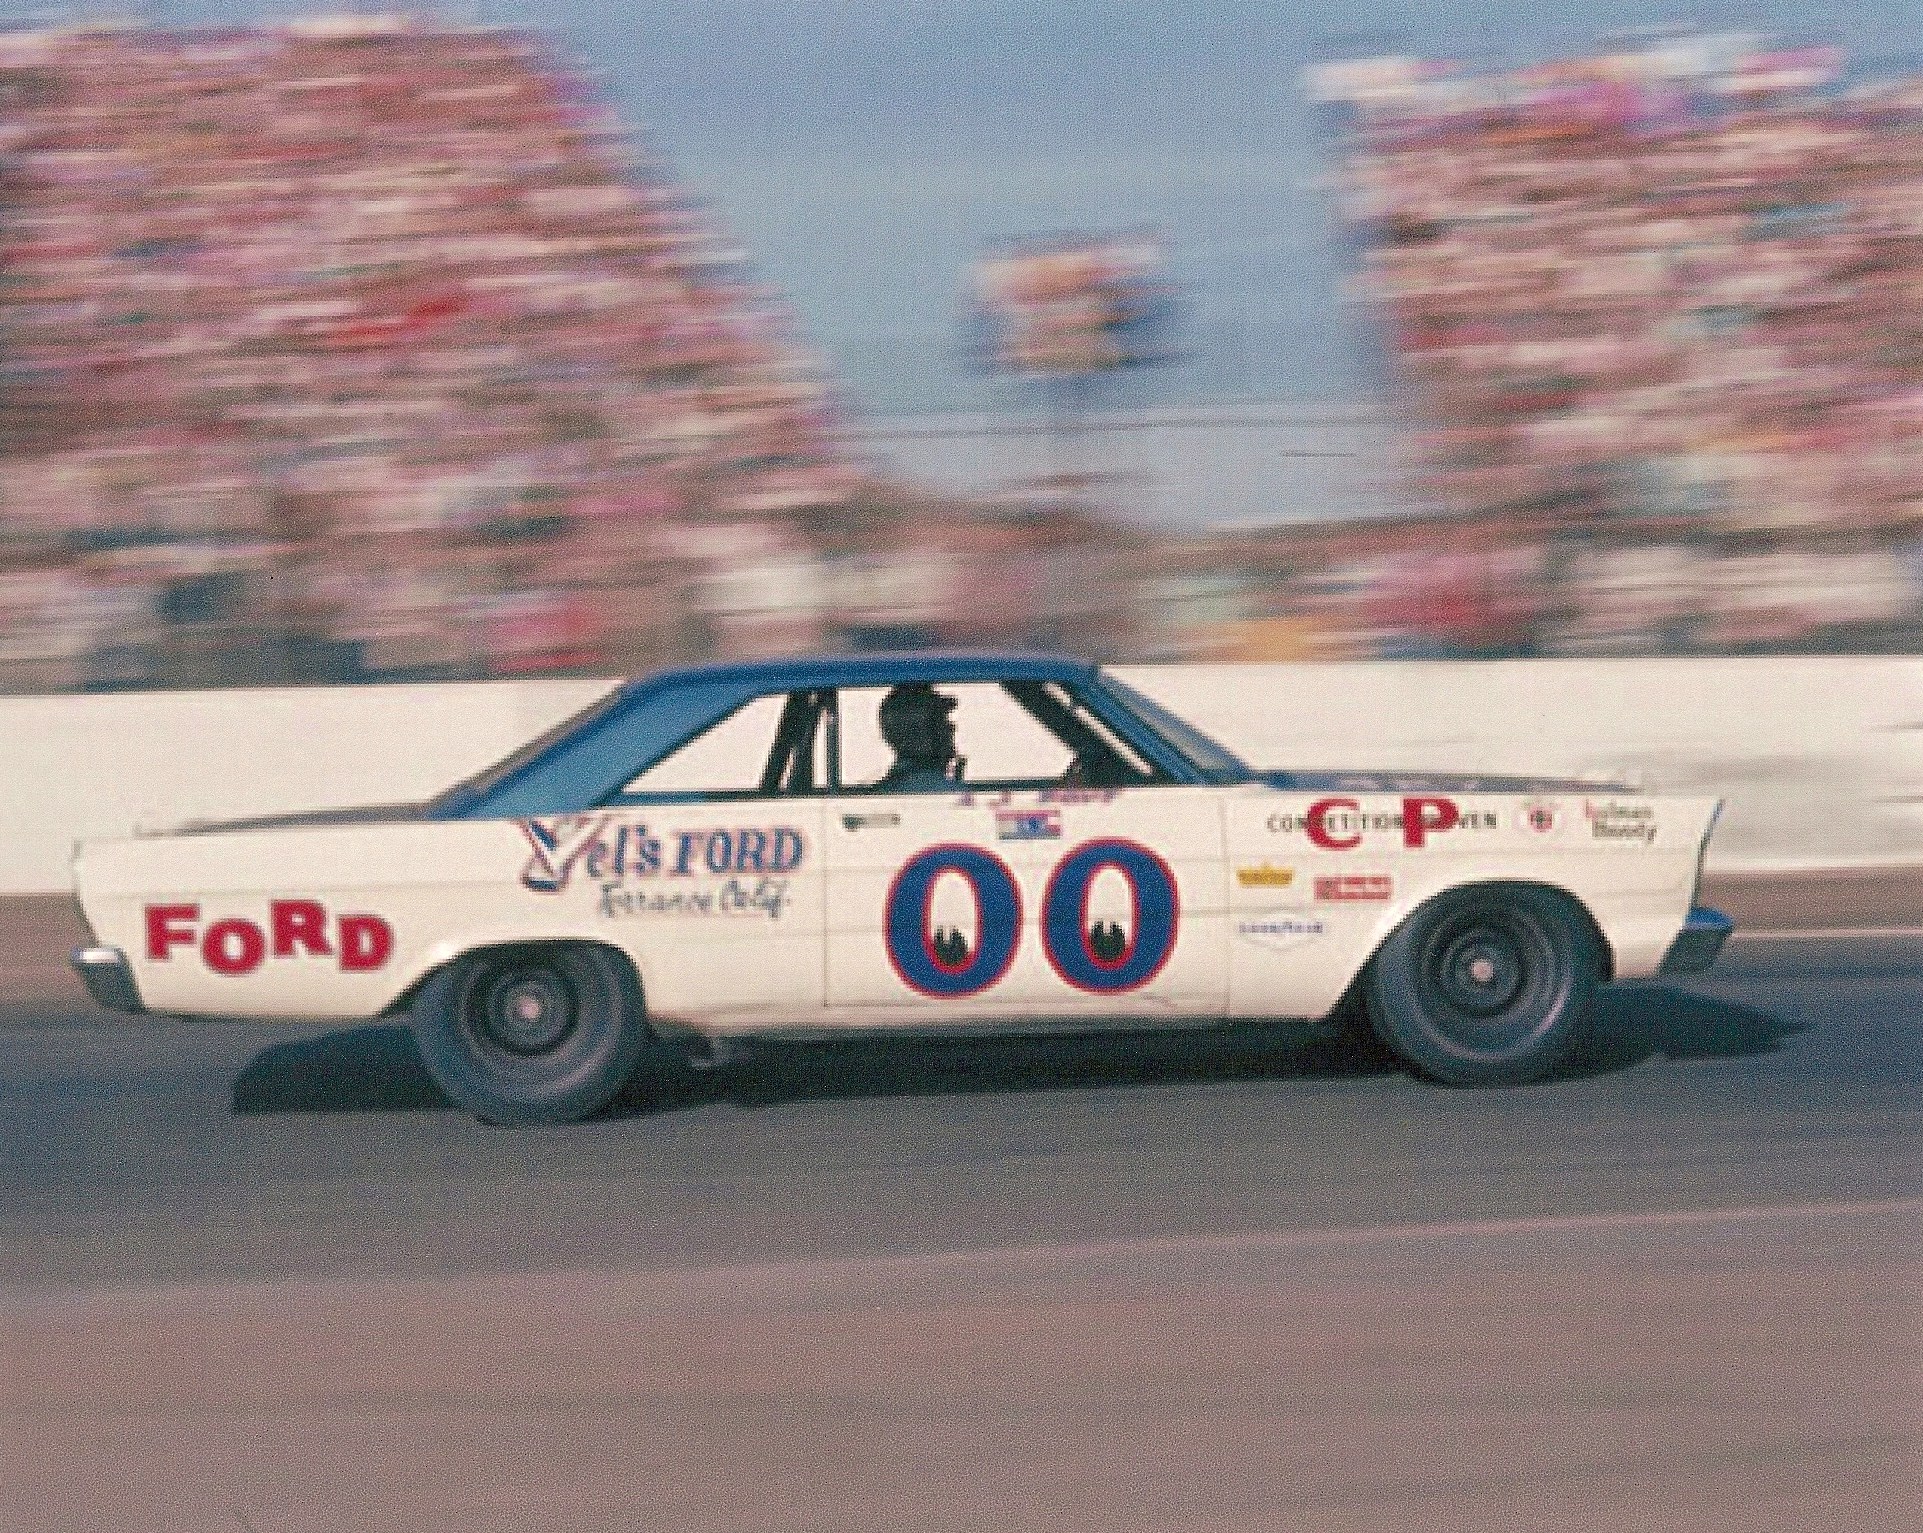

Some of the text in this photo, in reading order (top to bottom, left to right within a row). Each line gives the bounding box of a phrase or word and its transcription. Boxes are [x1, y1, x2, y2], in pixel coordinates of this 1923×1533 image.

[668, 825, 806, 878] FORD
[144, 899, 395, 977] FORD
[882, 836, 1180, 1000] 00
